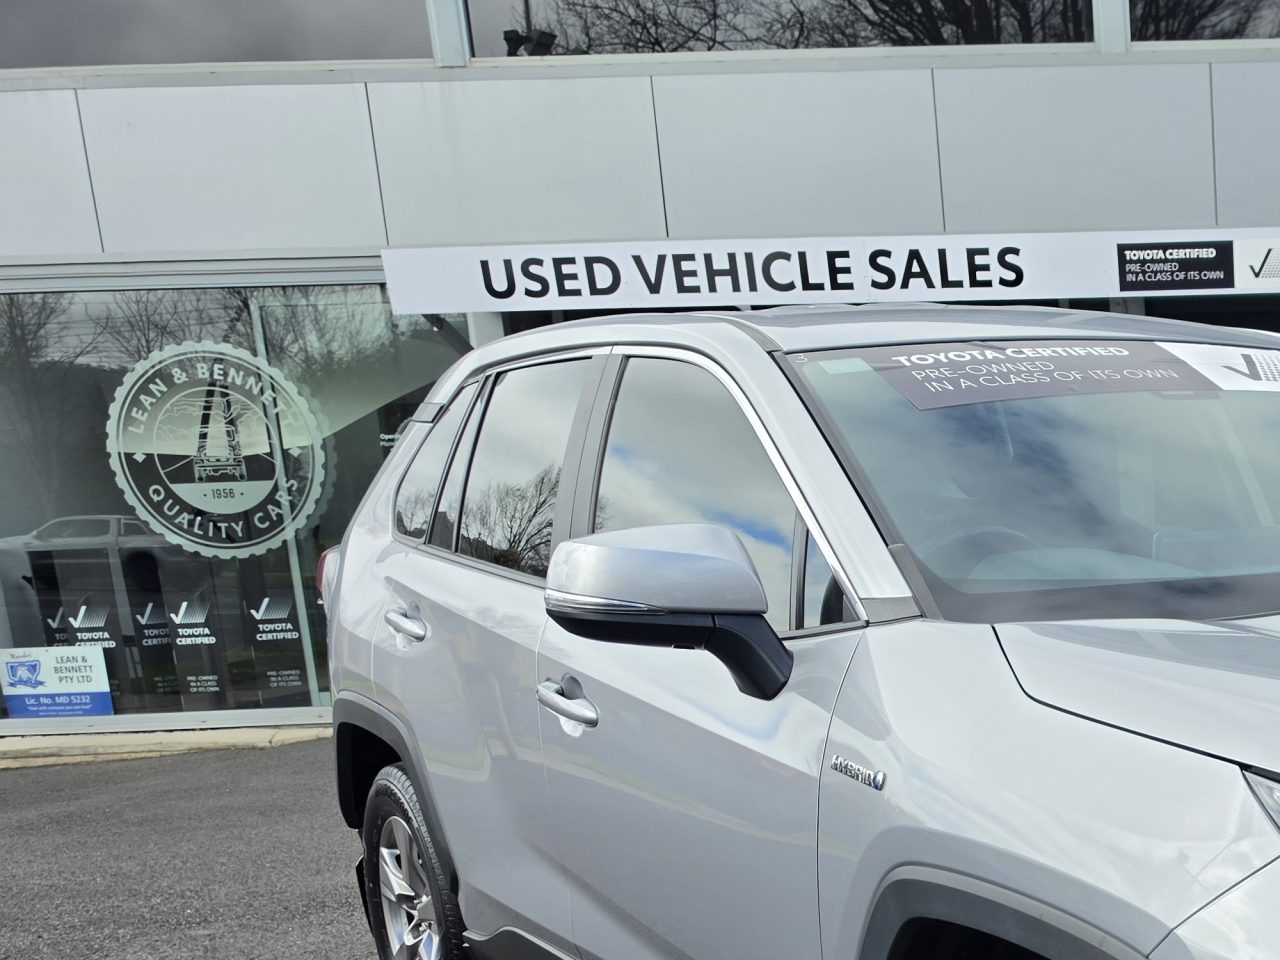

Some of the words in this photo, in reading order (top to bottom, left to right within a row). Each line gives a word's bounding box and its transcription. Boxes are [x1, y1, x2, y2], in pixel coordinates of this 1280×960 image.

[1124, 249, 1165, 260] TOYOTA
[1165, 248, 1217, 259] CERTIFIED
[1126, 262, 1179, 272] PRE-OWNED
[480, 255, 622, 299] USED
[631, 250, 854, 294] VEHICLE
[866, 246, 1025, 291] SALES
[1126, 273, 1136, 281] IN
[1137, 273, 1145, 281] A
[1145, 272, 1172, 281] CLASS
[1173, 271, 1186, 280] OF
[1187, 271, 1200, 279] ITS
[1200, 271, 1224, 279] OWN
[891, 350, 1002, 367] TOYOTA
[1005, 347, 1130, 359] CERTIFIED
[911, 361, 1055, 381] PRE-OWNED
[924, 379, 954, 392] IN
[960, 377, 978, 390] A
[979, 372, 1051, 386] CLASS
[1053, 370, 1089, 382] OF
[1089, 369, 1121, 380] ITS
[1122, 368, 1180, 380] OWN
[128, 377, 168, 434] LEAN
[171, 367, 189, 384] &
[196, 363, 299, 427] BENNETT
[211, 488, 235, 499] 1956
[148, 484, 244, 538] QUALITY
[254, 479, 298, 529] CARS
[258, 623, 293, 631] TOYOTA
[76, 632, 110, 640] TOYOTA
[144, 629, 169, 637] TOYOT
[256, 632, 299, 641] CERTIFIED
[176, 637, 216, 645] CERTIFIED
[55, 656, 78, 664] LEAN
[53, 665, 93, 674] BENNETT
[76, 675, 93, 683] LTD
[831, 754, 874, 787] HYBRID
